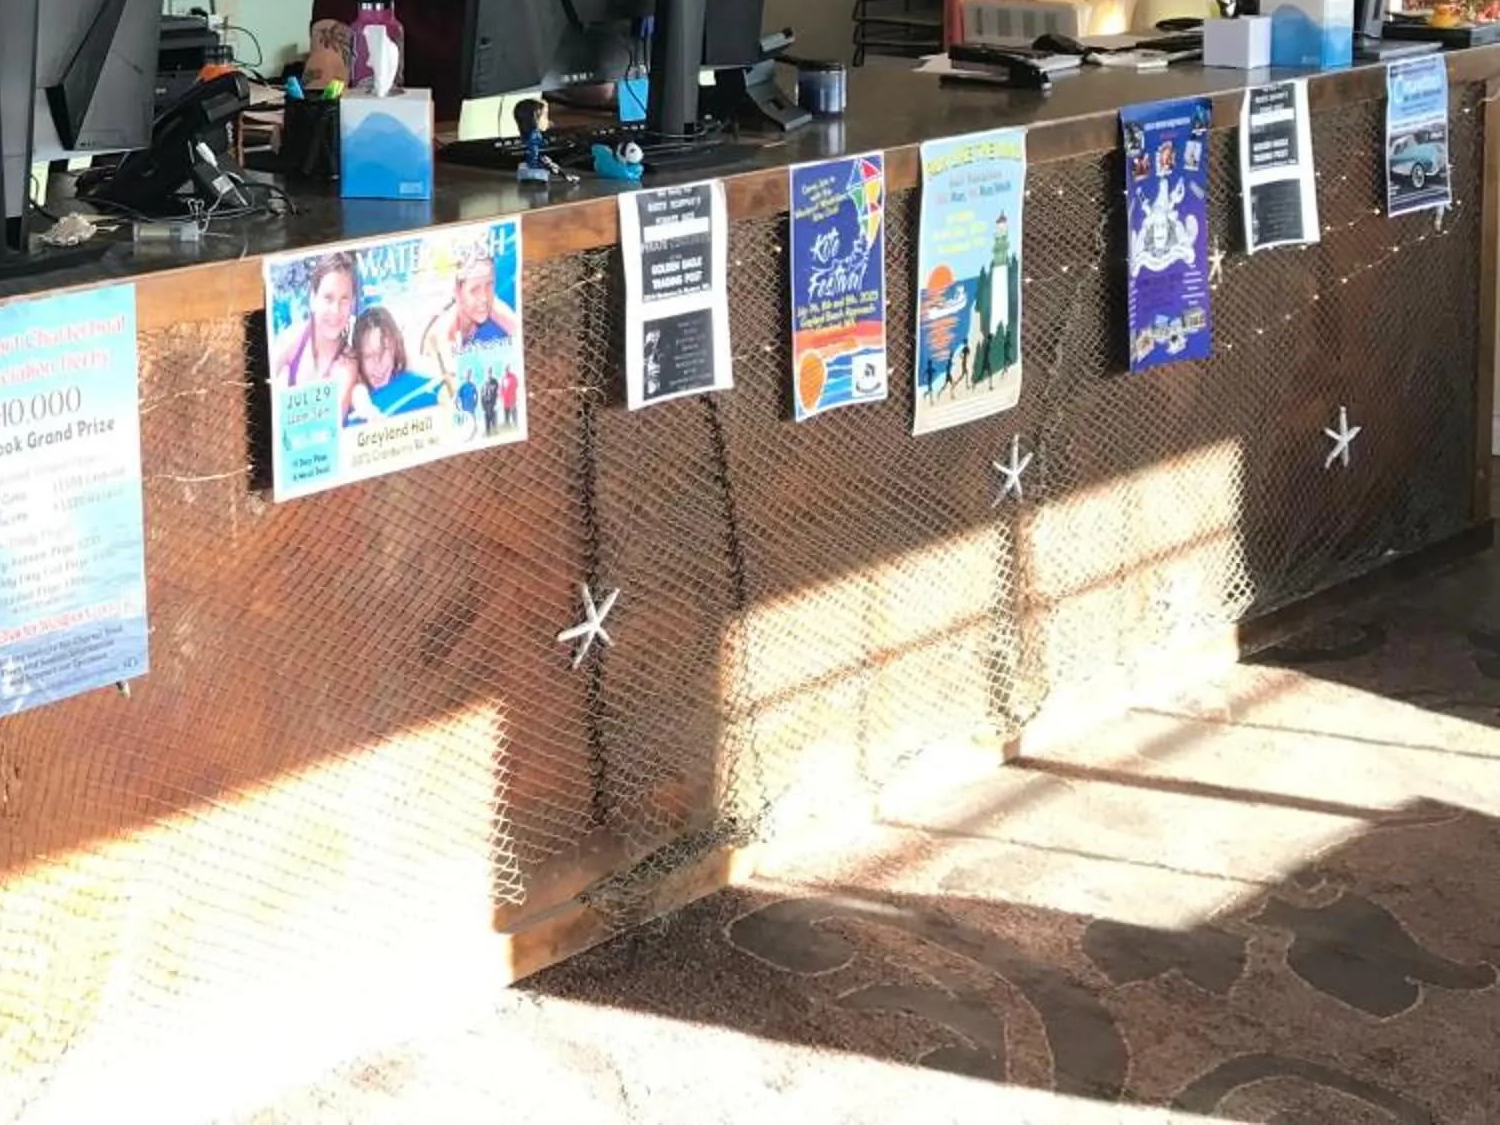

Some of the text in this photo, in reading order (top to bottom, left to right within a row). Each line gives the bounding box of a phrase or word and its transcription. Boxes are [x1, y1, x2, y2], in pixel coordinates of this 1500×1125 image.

[809, 227, 841, 264] Kite
[808, 260, 869, 303] Festival
[27, 422, 73, 450] Grand
[77, 416, 116, 439] Prize
[411, 415, 434, 436] Hall
